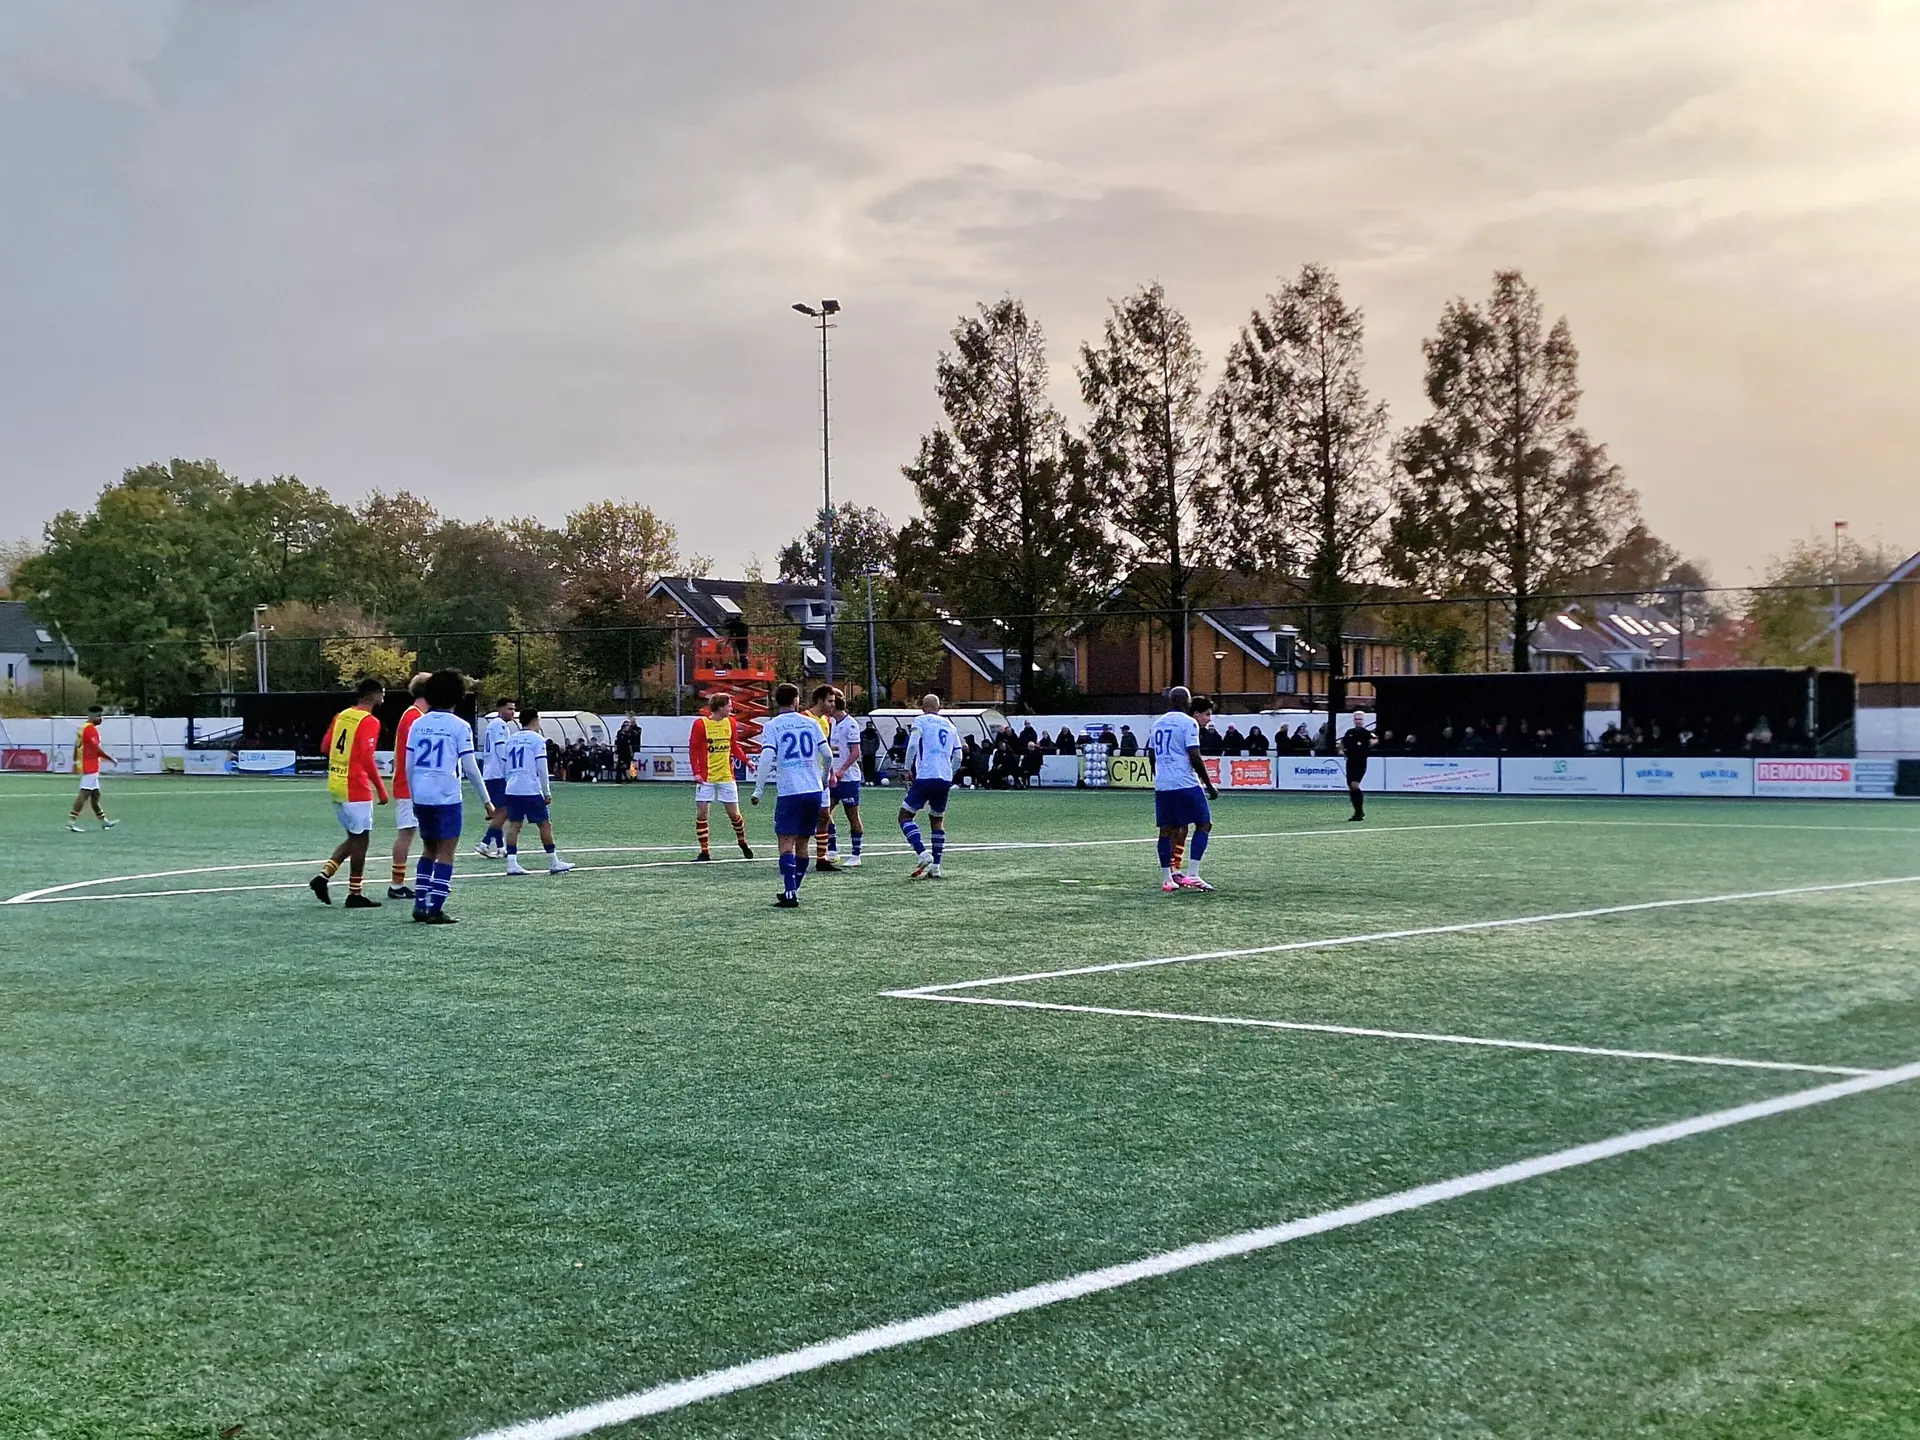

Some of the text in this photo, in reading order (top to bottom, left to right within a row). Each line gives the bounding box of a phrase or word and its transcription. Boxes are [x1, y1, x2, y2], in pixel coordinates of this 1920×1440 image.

[336, 728, 347, 755] 4
[781, 732, 813, 760] 20
[939, 729, 948, 748] 6
[1155, 730, 1173, 755] 97
[415, 739, 444, 768] 21
[509, 746, 525, 769] 11
[1295, 767, 1339, 776] Knipmeijer
[1759, 764, 1843, 780] REMONDIS
